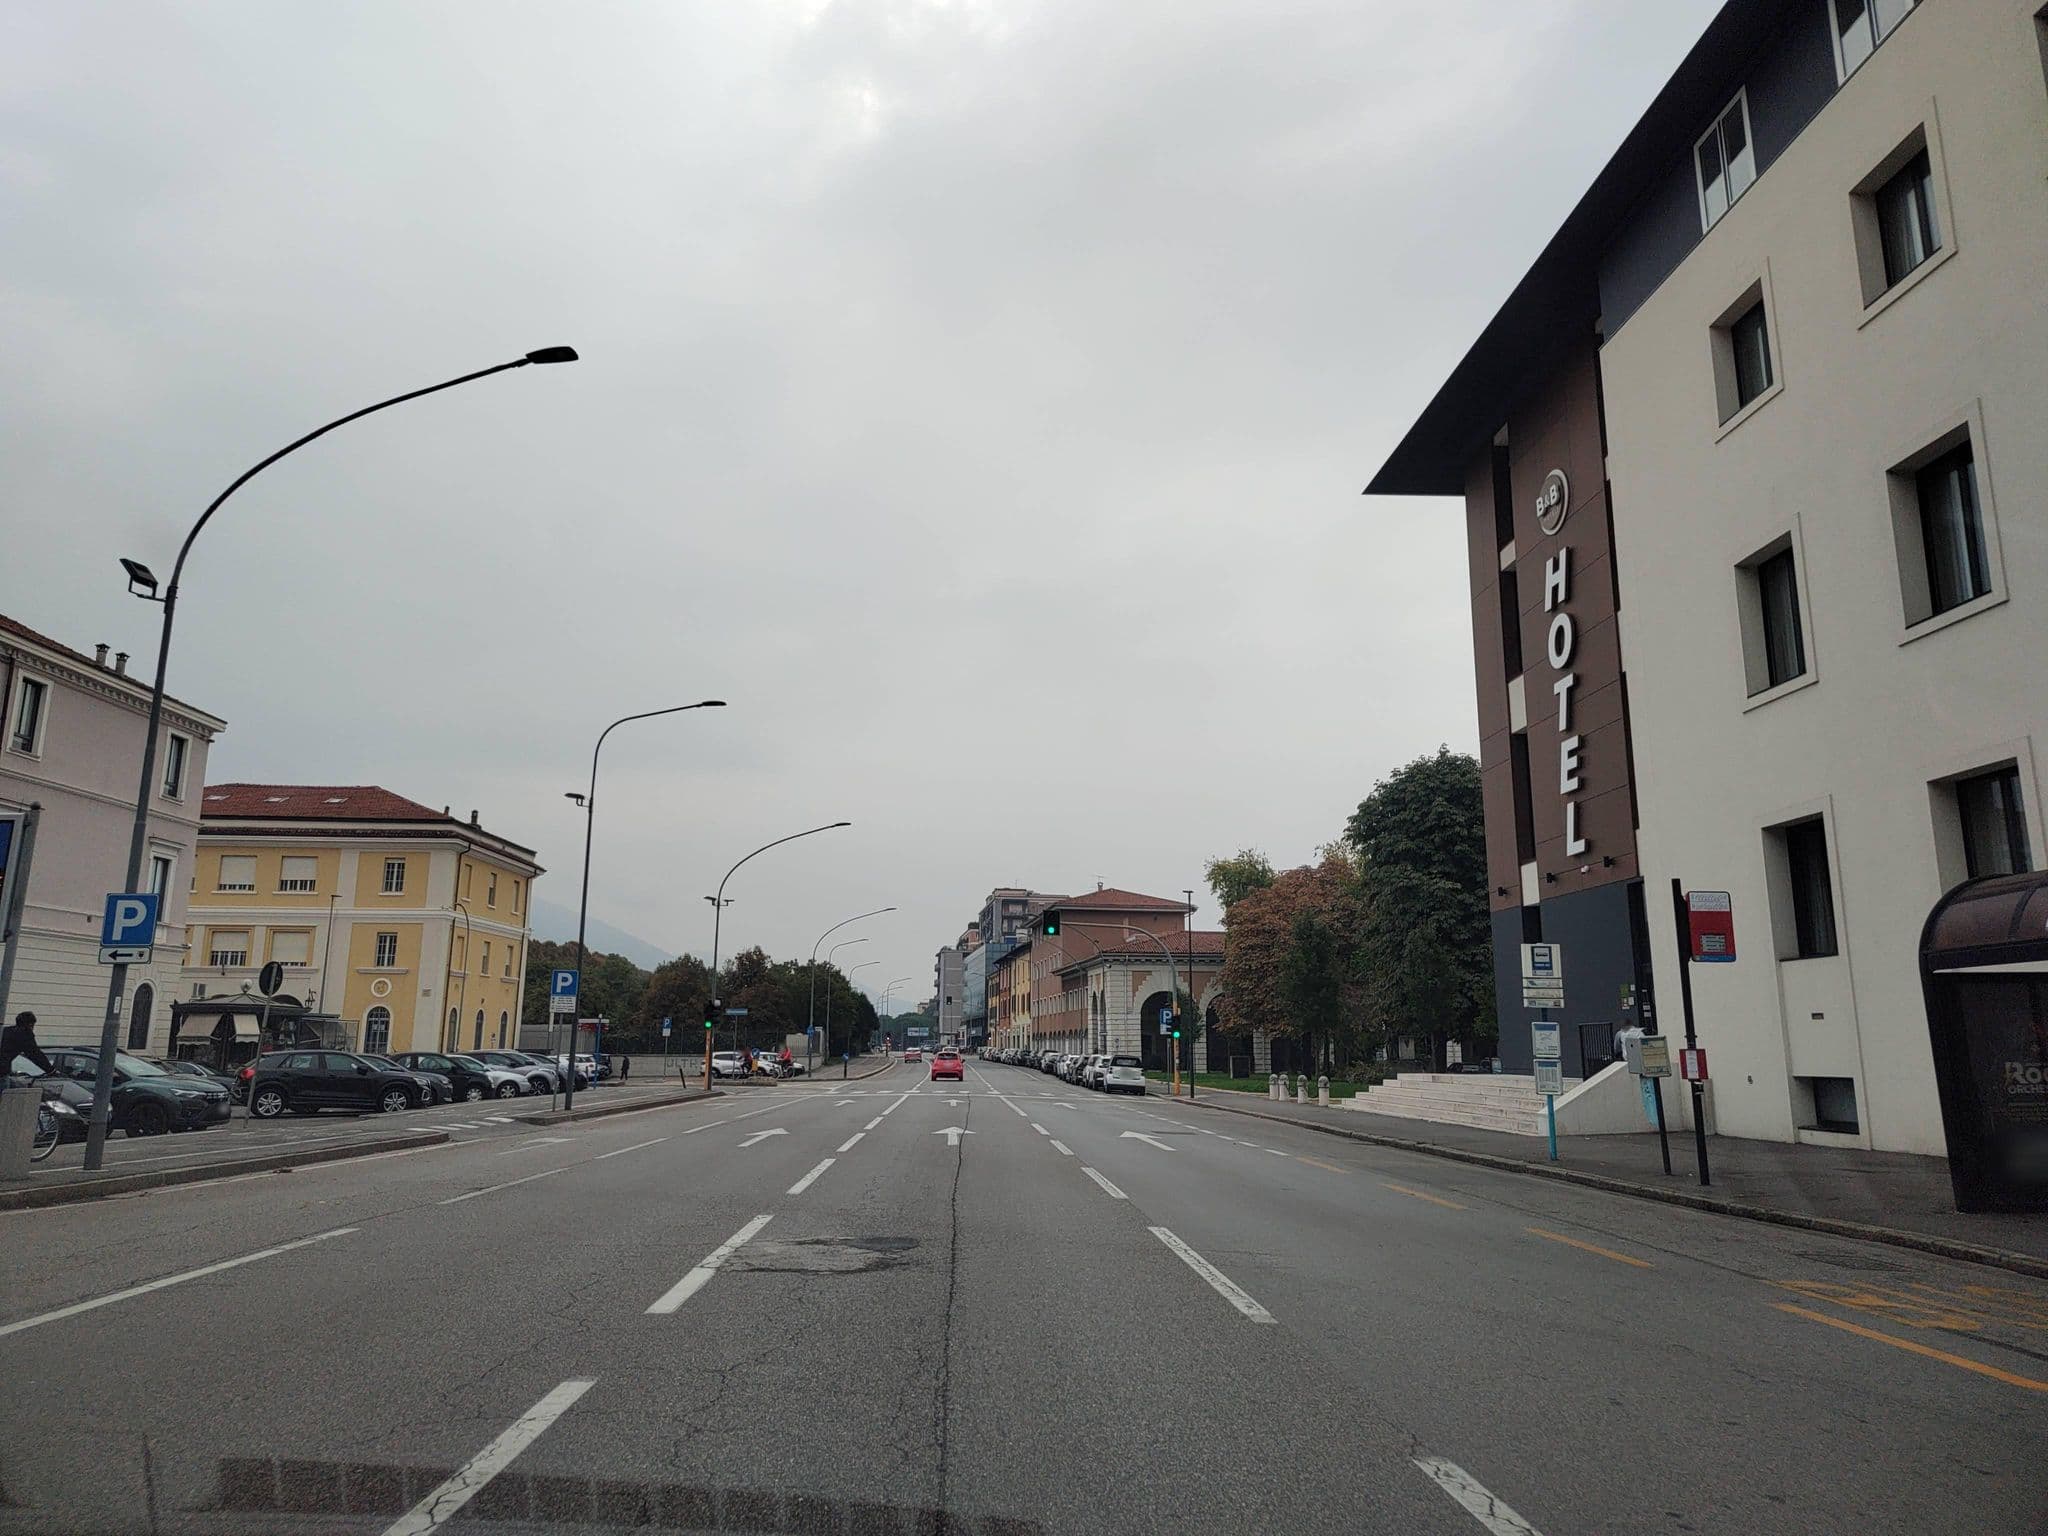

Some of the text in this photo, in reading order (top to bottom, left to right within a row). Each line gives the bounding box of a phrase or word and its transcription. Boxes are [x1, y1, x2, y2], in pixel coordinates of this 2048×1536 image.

[1536, 484, 1558, 518] B&B
[1544, 546, 1588, 857] HOTEL
[112, 900, 147, 941] P
[556, 972, 573, 993] P
[664, 1018, 670, 1028] P
[1163, 1010, 1172, 1023] P
[2008, 1085, 2048, 1095] ORCHE
